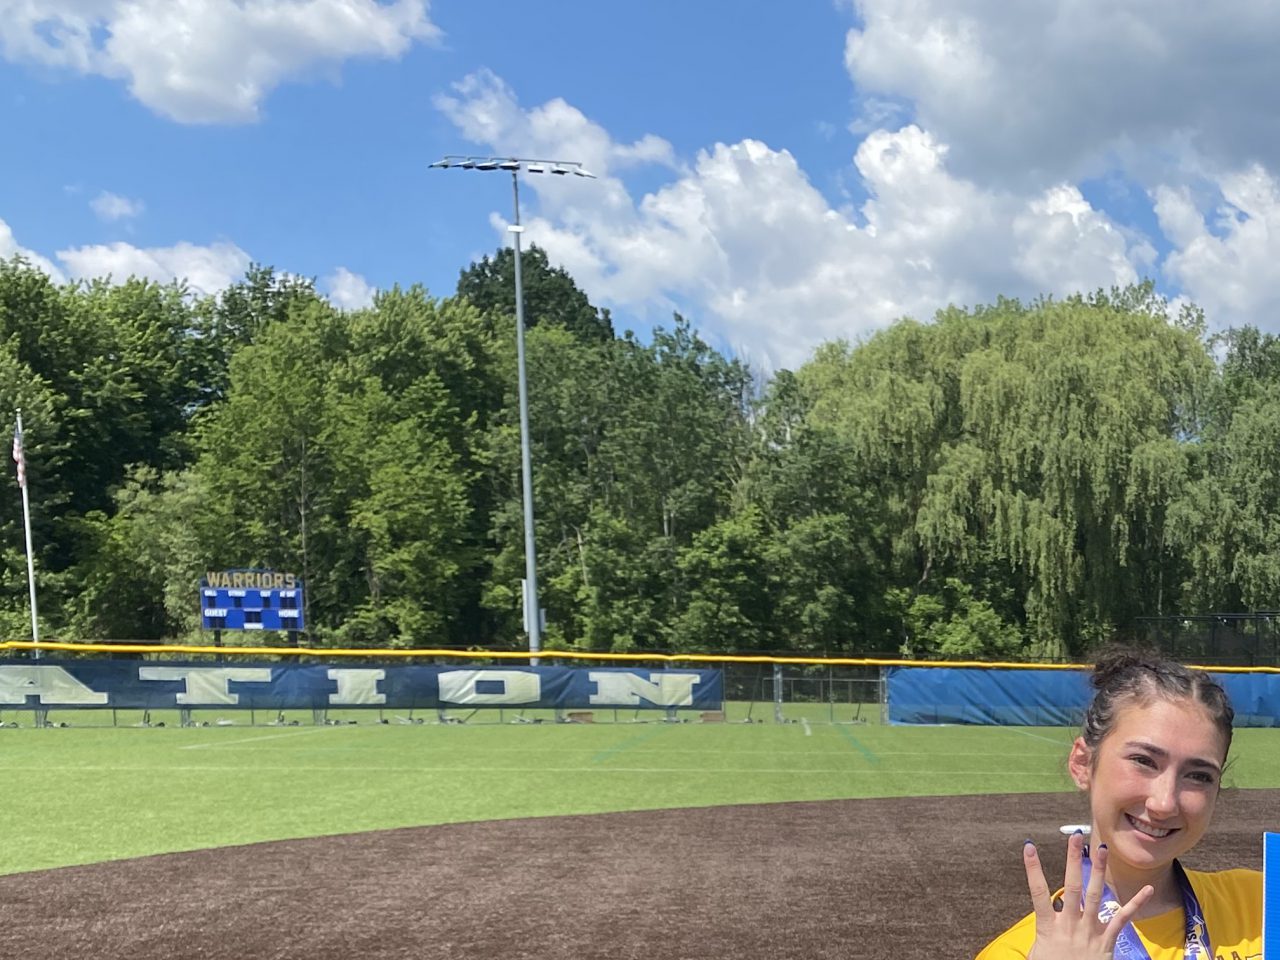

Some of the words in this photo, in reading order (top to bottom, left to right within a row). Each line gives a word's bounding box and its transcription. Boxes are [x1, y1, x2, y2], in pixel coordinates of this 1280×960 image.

[207, 572, 295, 588] WARRIORS
[204, 609, 227, 617] GUEST
[278, 610, 299, 618] HOME
